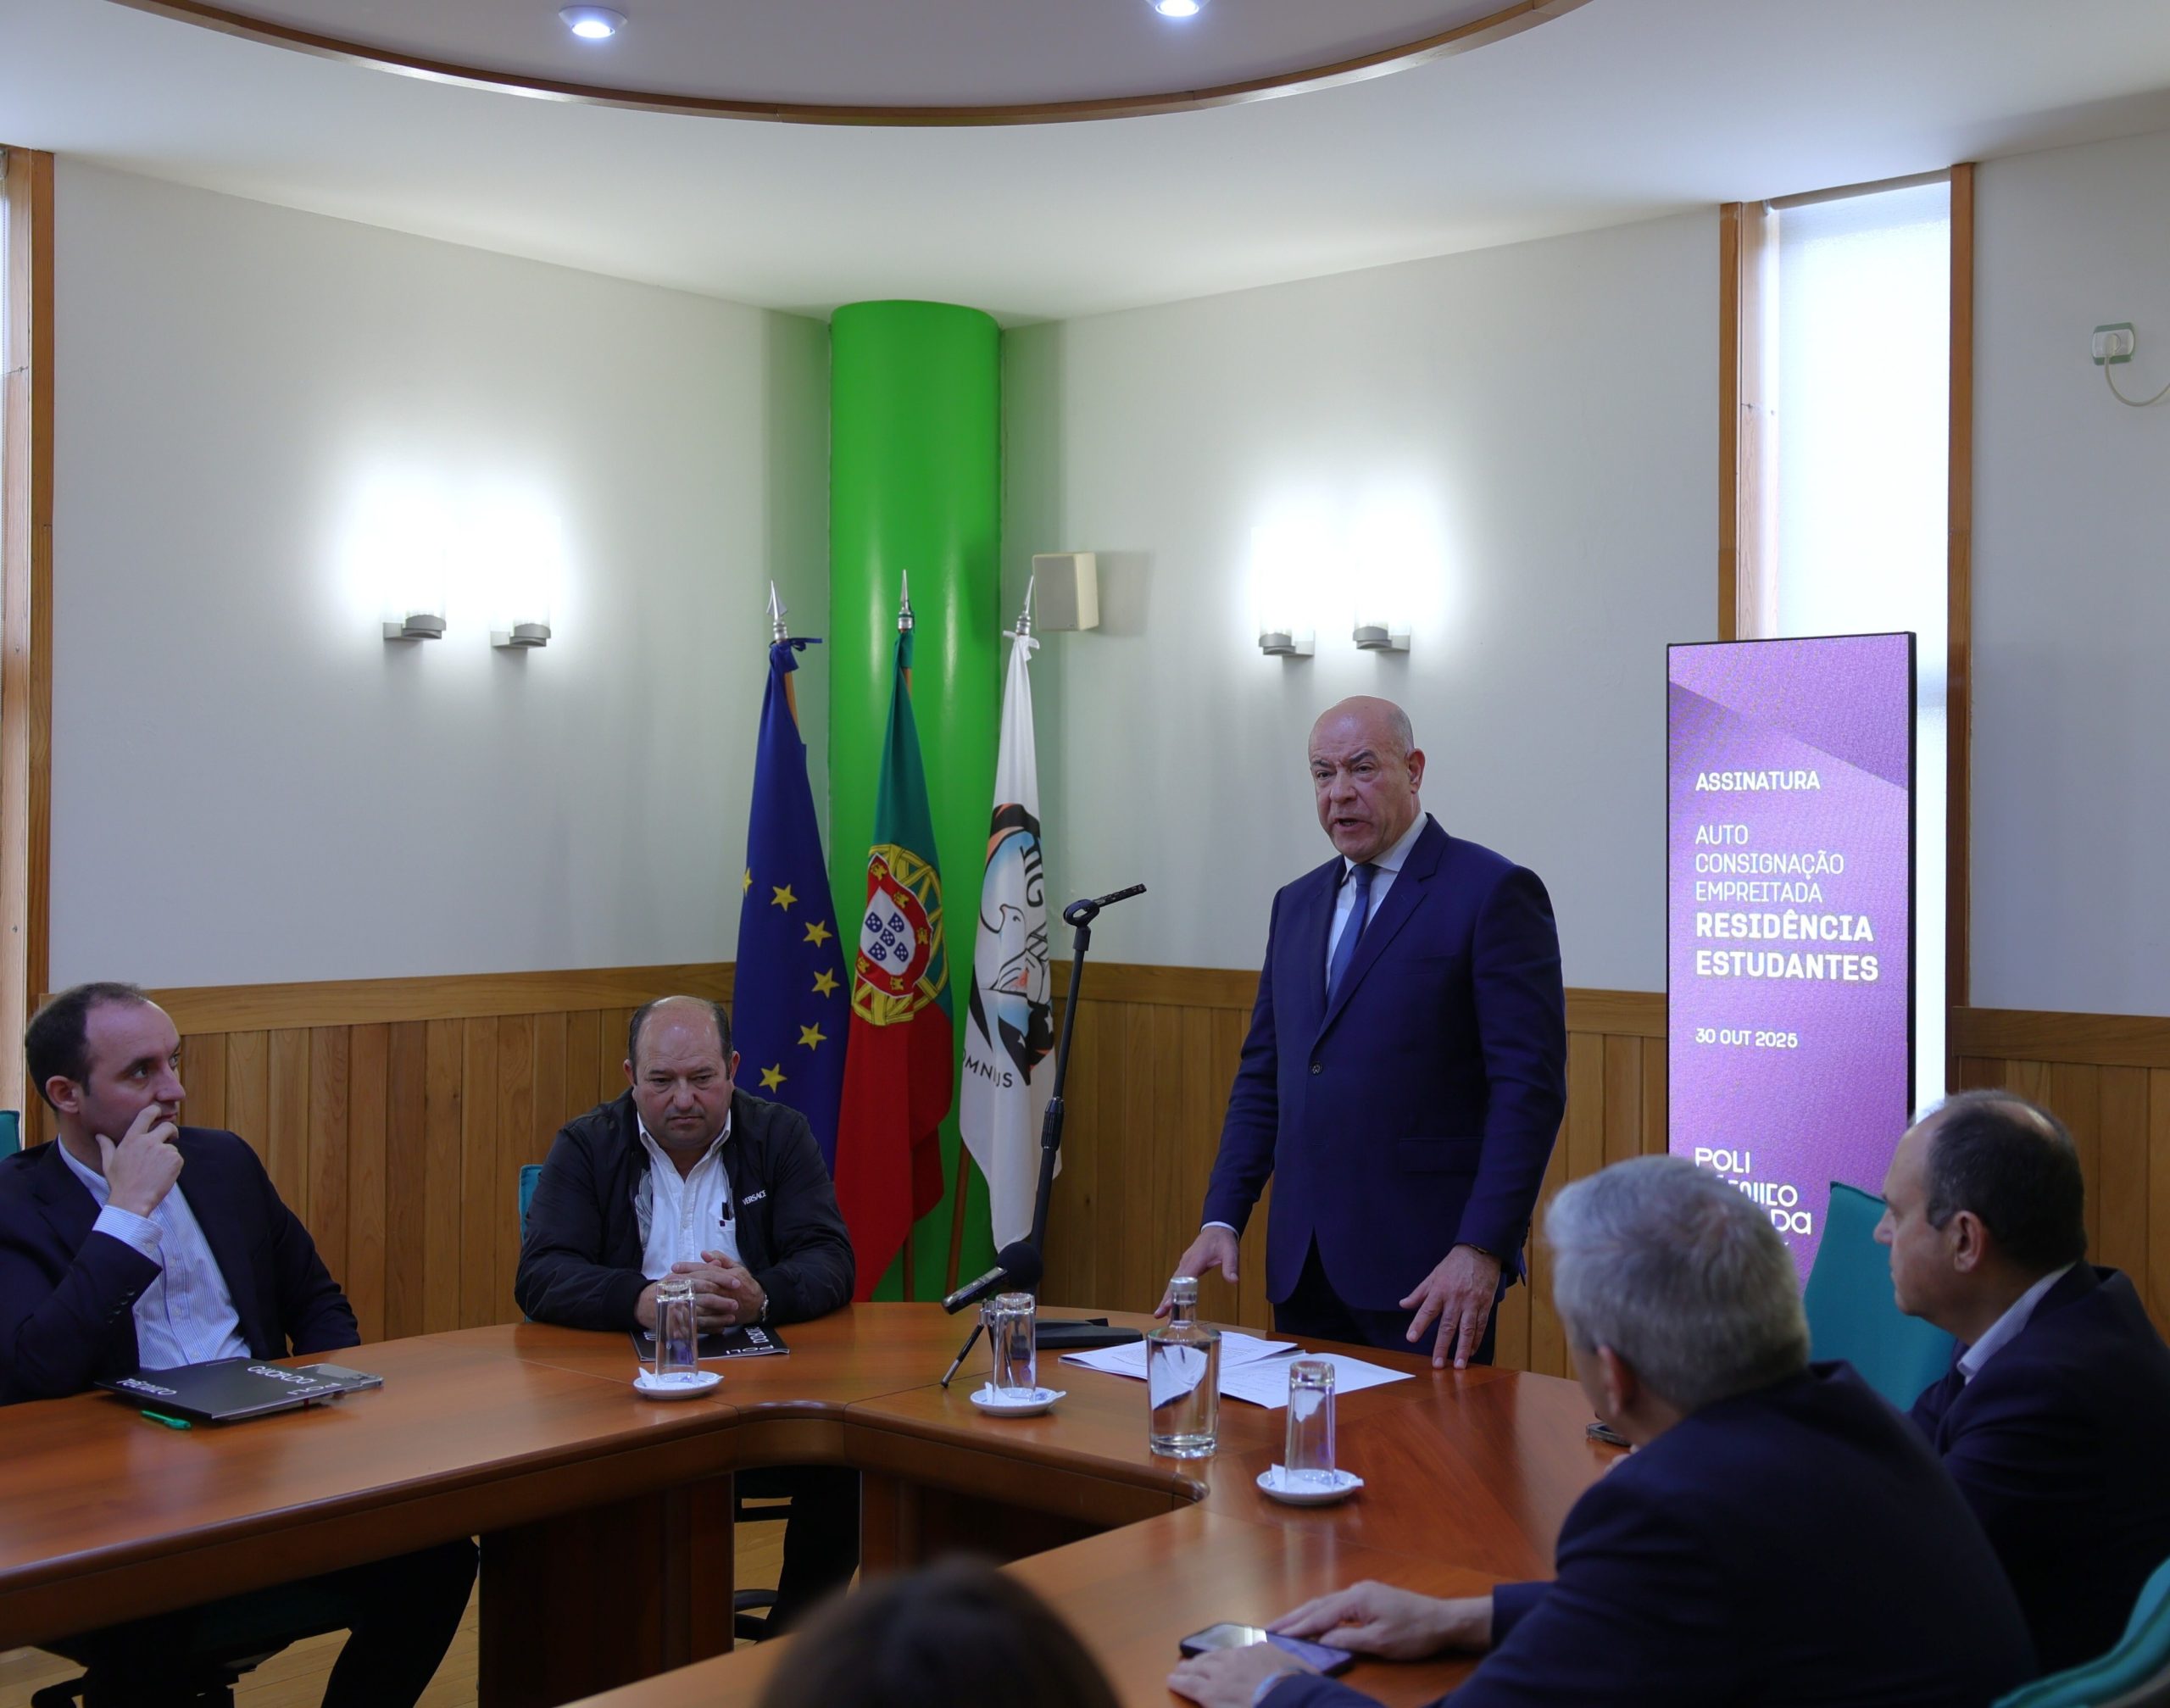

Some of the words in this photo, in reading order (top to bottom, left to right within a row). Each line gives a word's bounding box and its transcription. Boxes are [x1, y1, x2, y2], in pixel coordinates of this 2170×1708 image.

[1695, 771, 1821, 792] ASSINATURA
[1694, 825, 1749, 845] AUTO
[1695, 850, 1844, 880] CONSIGNAÇÃO
[1695, 881, 1823, 903] EMPREITADA
[1696, 909, 1874, 942] RESIDÊNCIA
[1696, 950, 1878, 981] ESTUDANTES
[1695, 1027, 1717, 1044] 30
[1720, 1029, 1752, 1046] OUT
[1755, 1031, 1799, 1049] 2025
[1694, 1147, 1750, 1174] POLI
[1716, 1175, 1798, 1207] NICO
